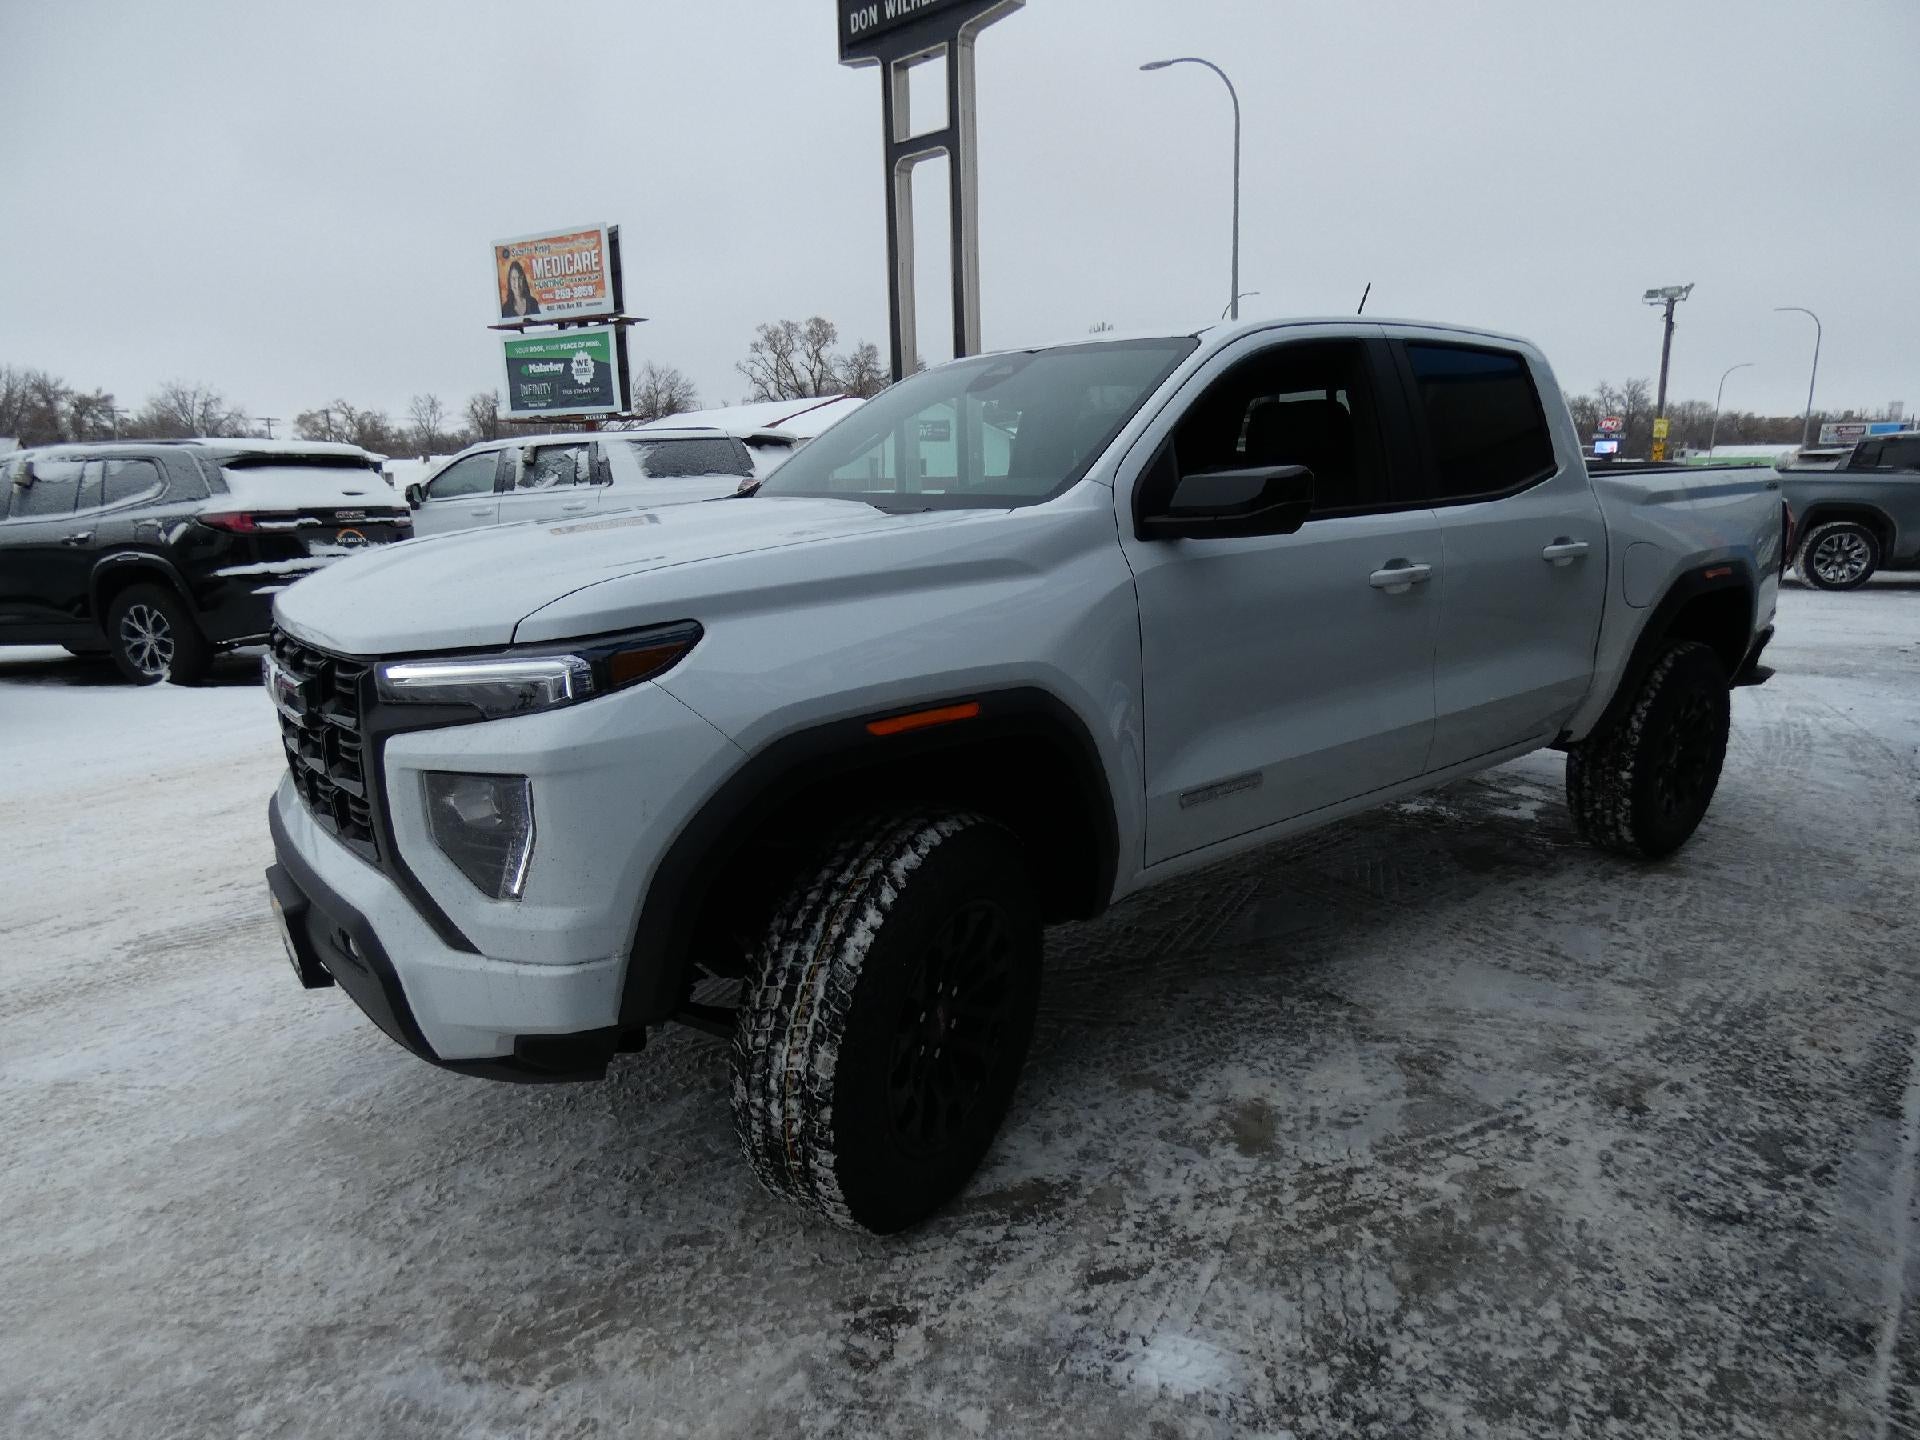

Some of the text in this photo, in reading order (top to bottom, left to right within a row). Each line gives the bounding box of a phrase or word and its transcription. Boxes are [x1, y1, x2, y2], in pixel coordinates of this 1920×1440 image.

[850, 4, 878, 34] DON
[531, 249, 600, 279] MEDICARE
[576, 359, 588, 367] WE
